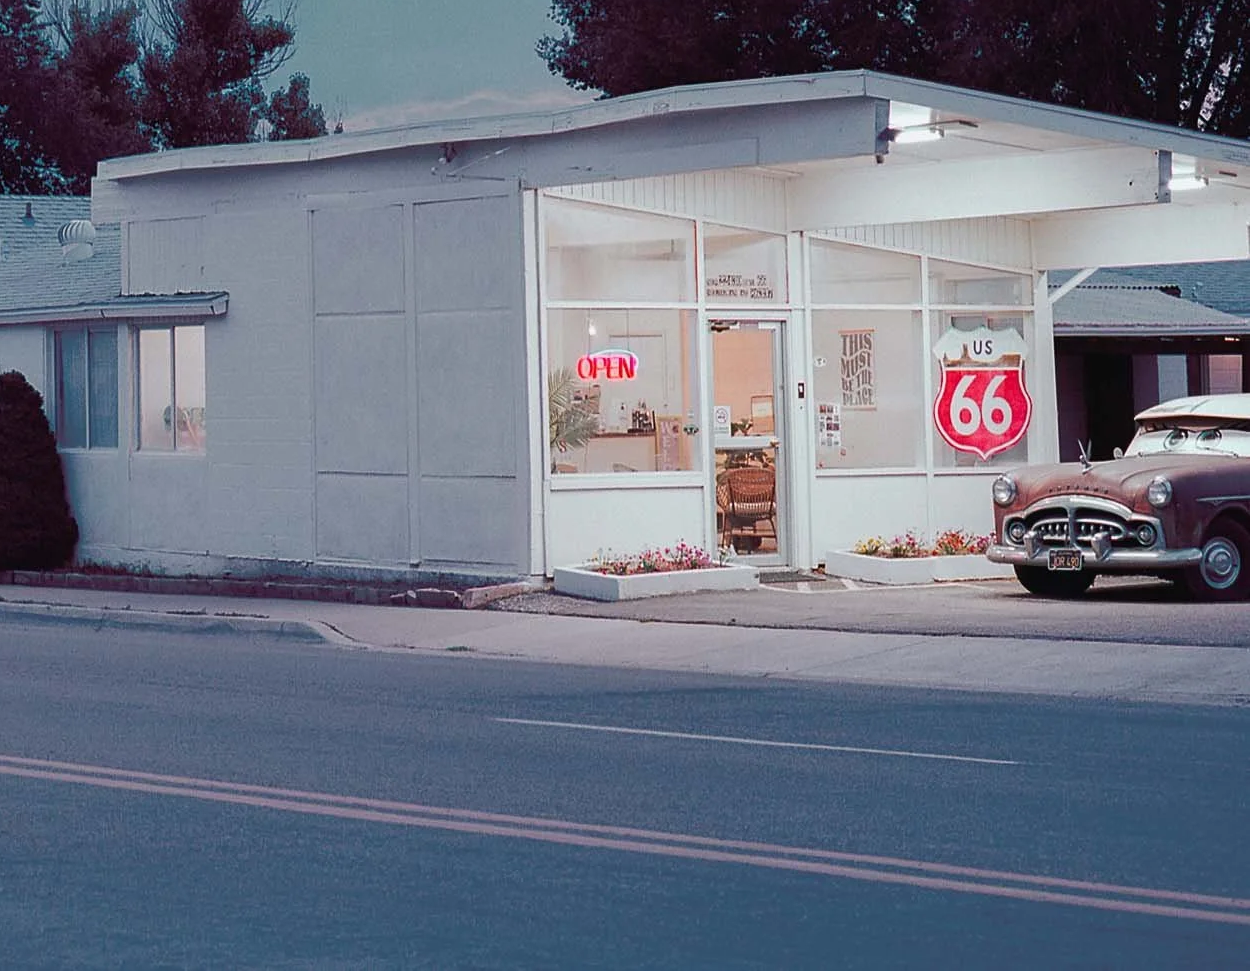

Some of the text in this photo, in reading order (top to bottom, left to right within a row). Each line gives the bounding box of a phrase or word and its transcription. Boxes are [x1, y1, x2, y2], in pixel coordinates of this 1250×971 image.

[840, 333, 872, 357] THIS
[973, 340, 993, 355] US
[578, 355, 635, 379] OPEN
[841, 351, 871, 378] MUST
[841, 369, 872, 391] BE THE
[842, 387, 874, 406] PLACE
[950, 374, 1013, 436] 66
